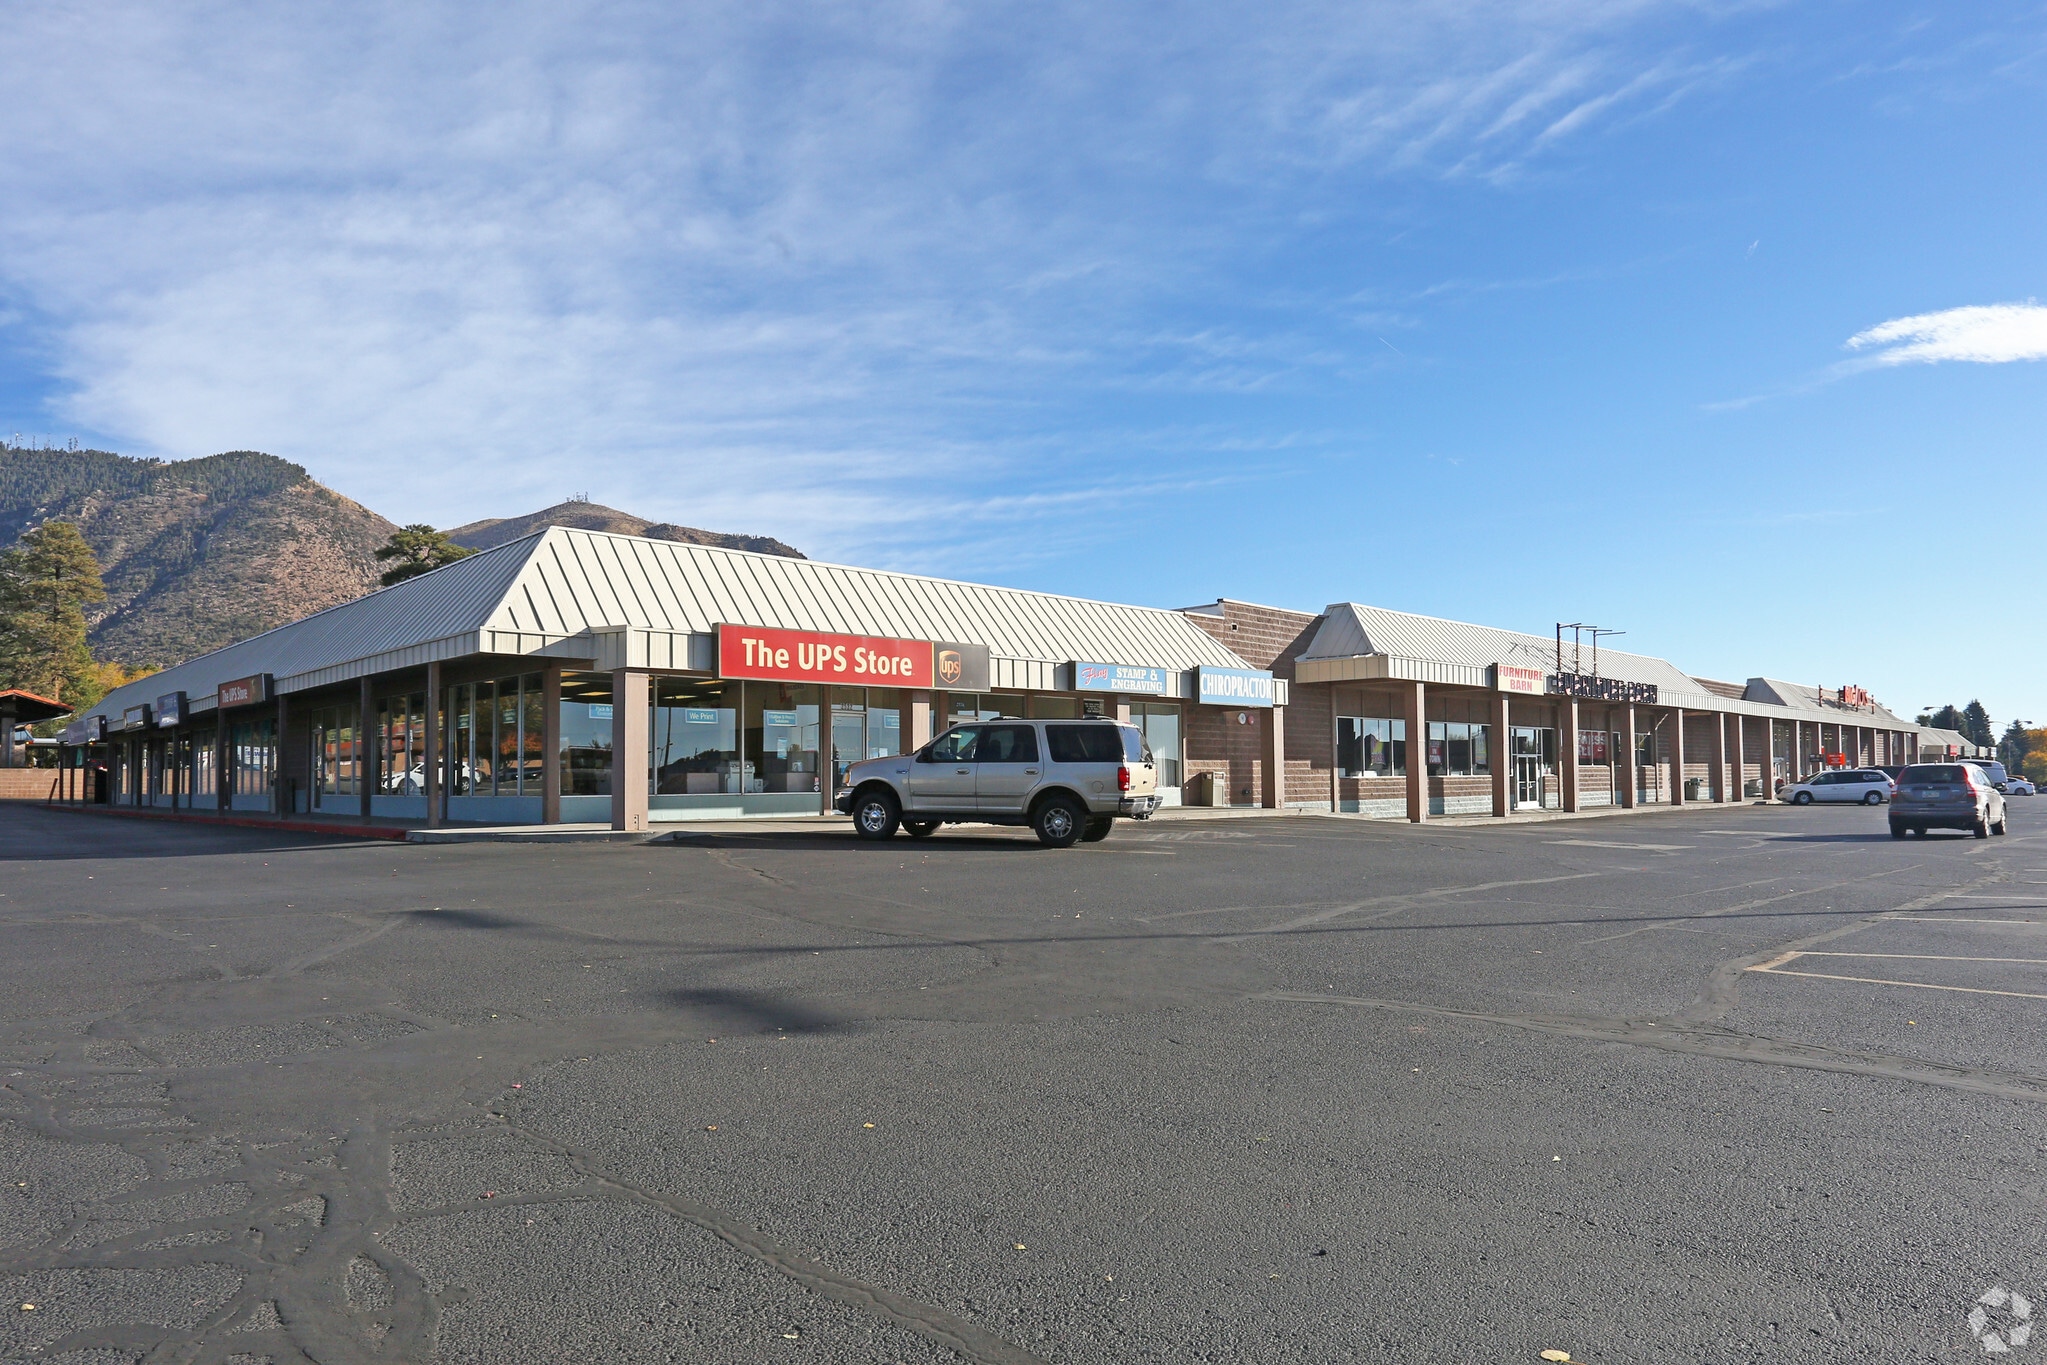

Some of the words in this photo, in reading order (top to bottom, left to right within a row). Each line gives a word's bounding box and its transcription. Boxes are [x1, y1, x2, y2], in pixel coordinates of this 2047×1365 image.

[741, 638, 789, 669] The
[798, 643, 847, 672] UPS
[854, 648, 913, 676] Store
[941, 657, 960, 678] ups
[1116, 667, 1147, 680] STAMP
[1149, 669, 1158, 681] &
[1499, 665, 1543, 681] FURNITURE
[1111, 678, 1163, 692] ENGRAVING
[1200, 673, 1272, 699] CHIROPRACTOR
[1510, 679, 1532, 692] BARN
[229, 687, 237, 702] UPS
[237, 686, 248, 700] Store
[689, 711, 700, 720] We
[700, 711, 714, 721] Print
